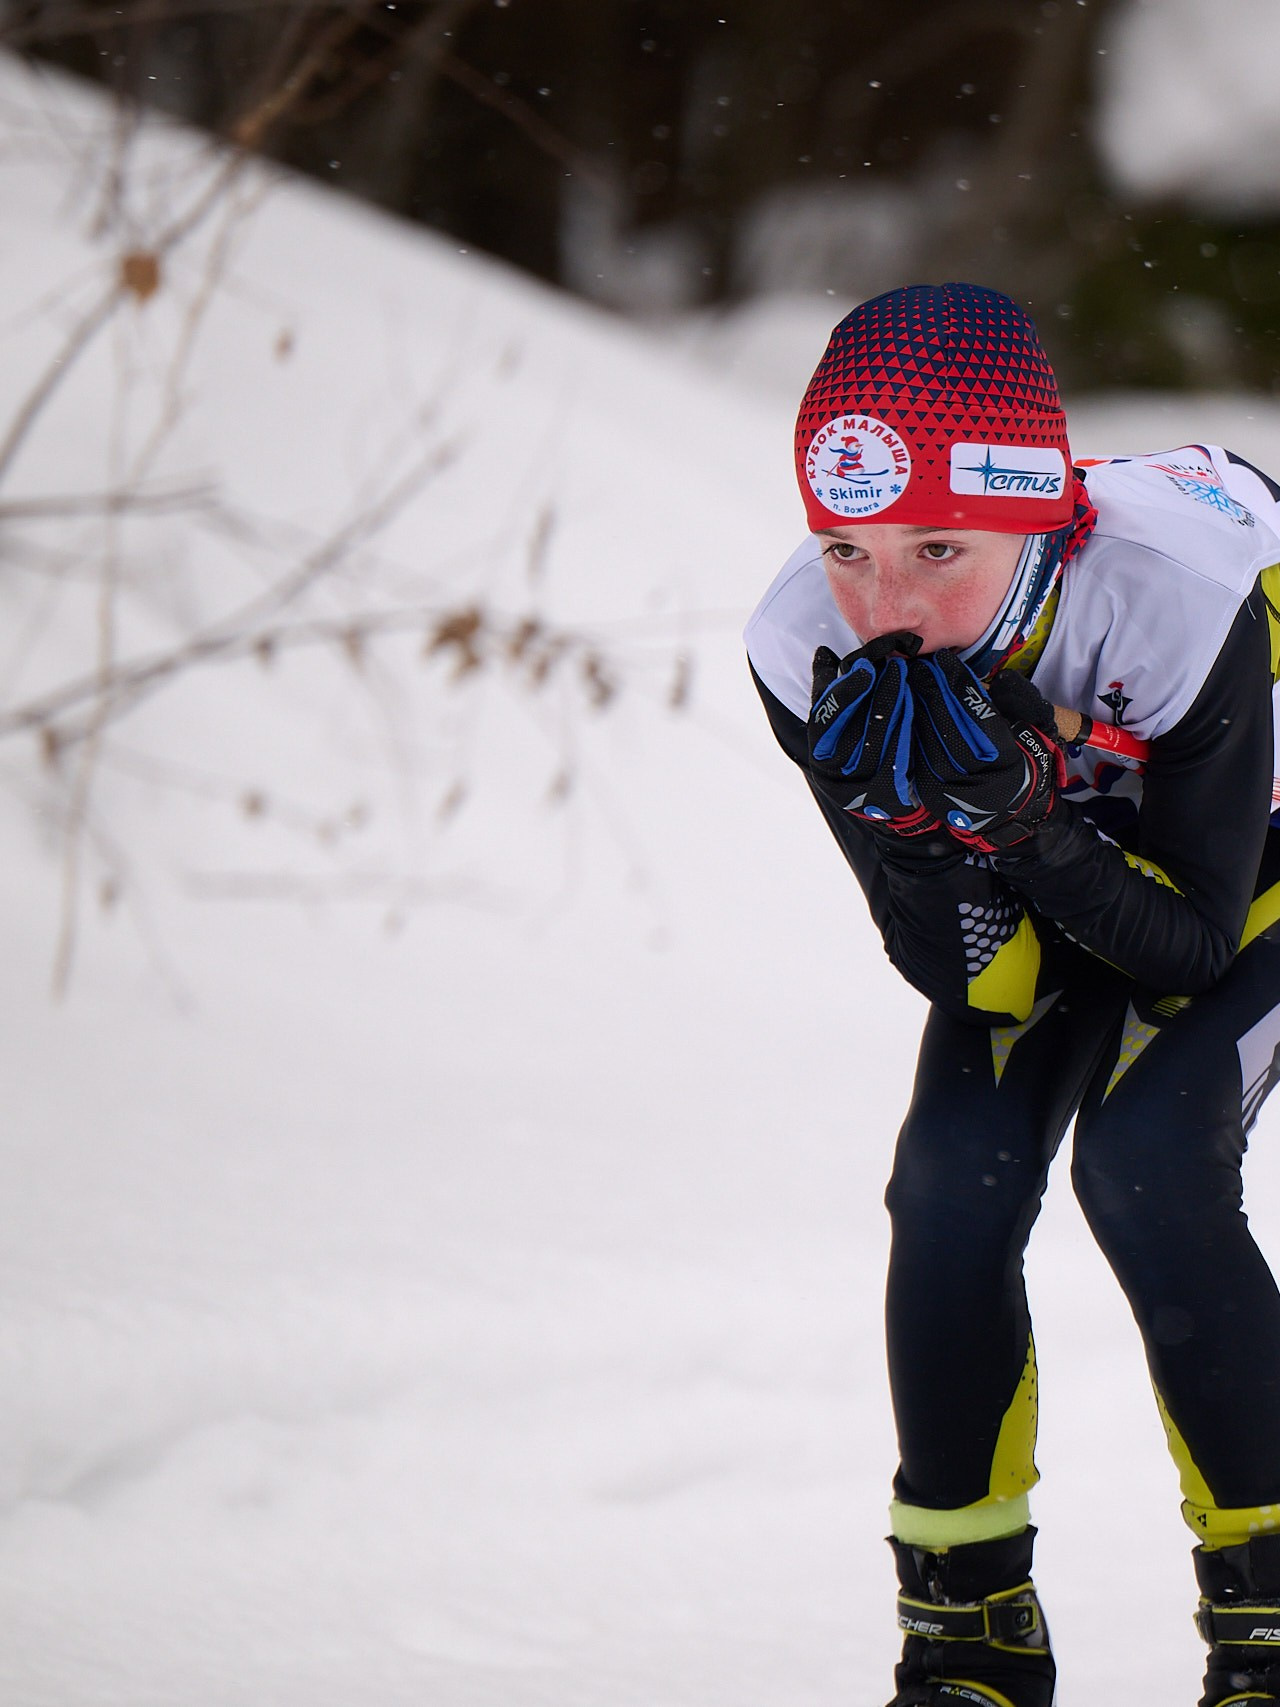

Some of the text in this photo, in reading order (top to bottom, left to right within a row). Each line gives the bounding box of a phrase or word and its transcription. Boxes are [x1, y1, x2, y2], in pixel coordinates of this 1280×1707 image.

[808, 418, 908, 479] КУБОК МАЛЫША
[829, 487, 882, 500] Skimir
[844, 502, 879, 514] Вожега
[898, 1615, 943, 1635] CHER
